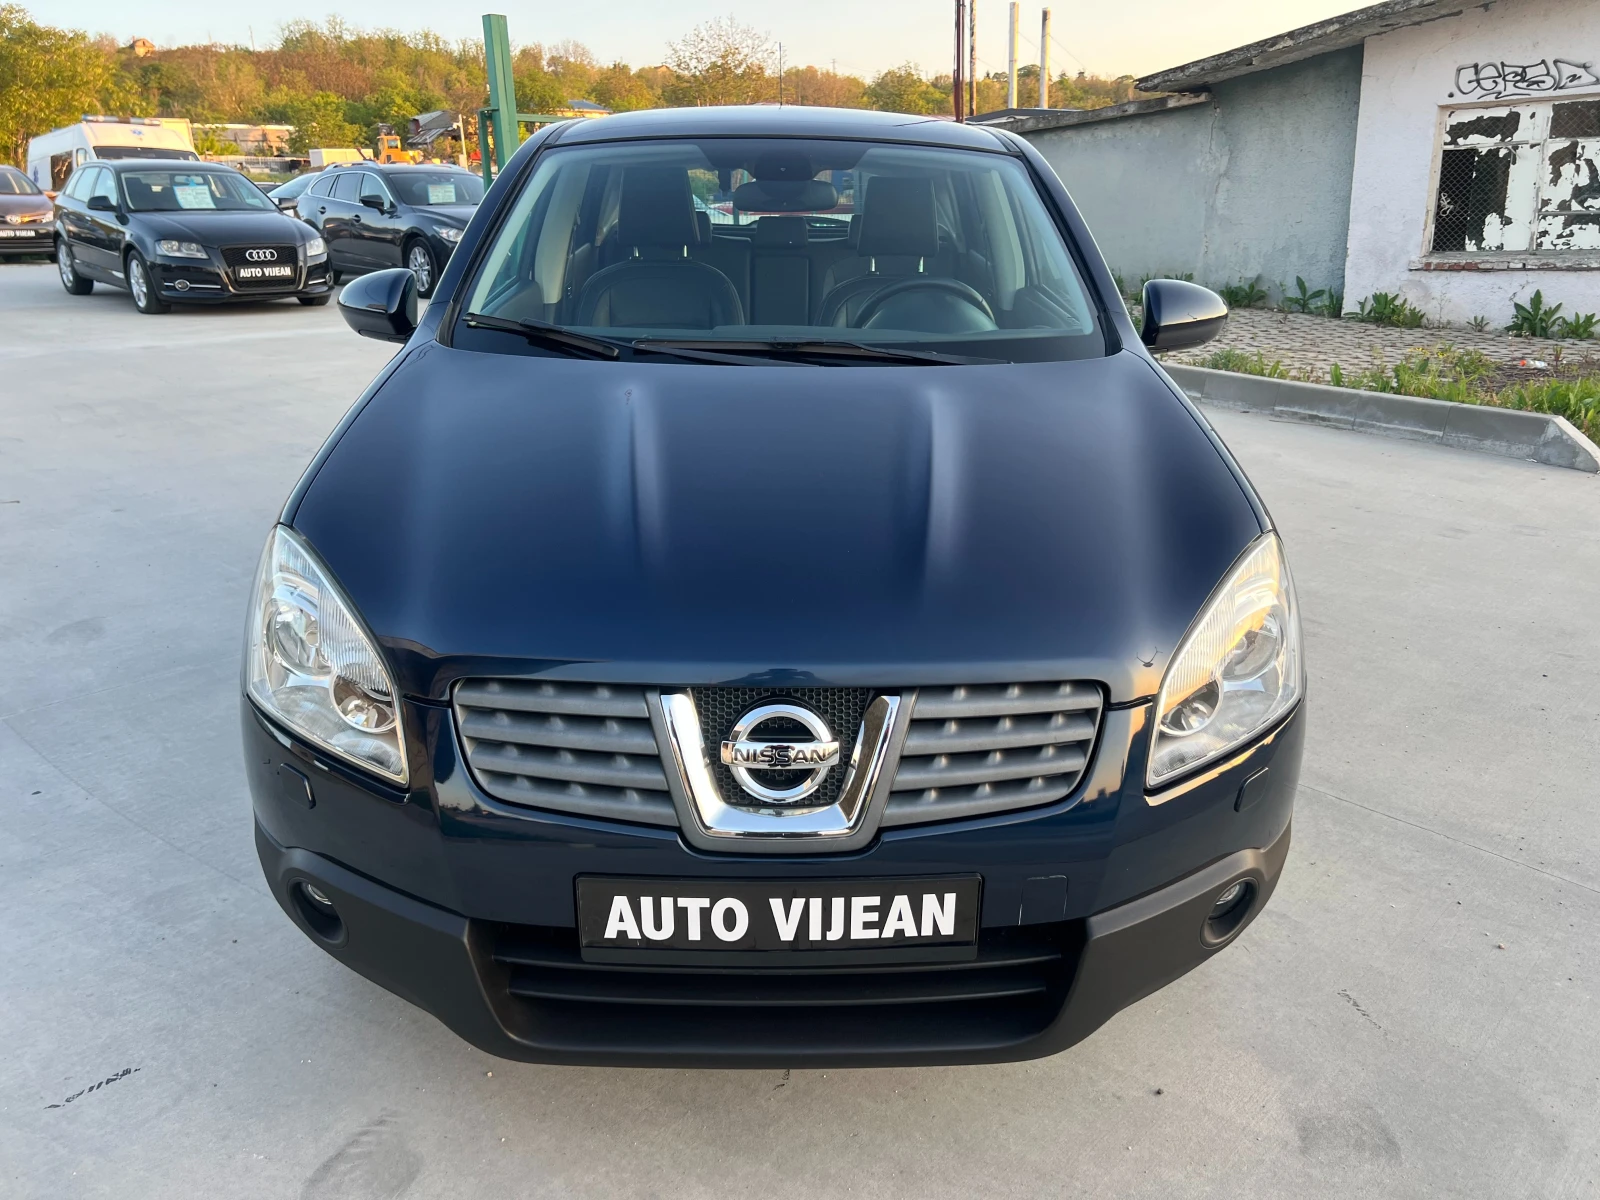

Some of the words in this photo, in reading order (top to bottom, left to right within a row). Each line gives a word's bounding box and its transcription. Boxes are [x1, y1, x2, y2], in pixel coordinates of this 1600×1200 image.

[240, 267, 263, 278] AUTO
[263, 266, 292, 277] VIJEAN
[732, 748, 827, 764] NISSAN
[603, 894, 749, 942] AUTO
[768, 892, 957, 942] VIJEAN
